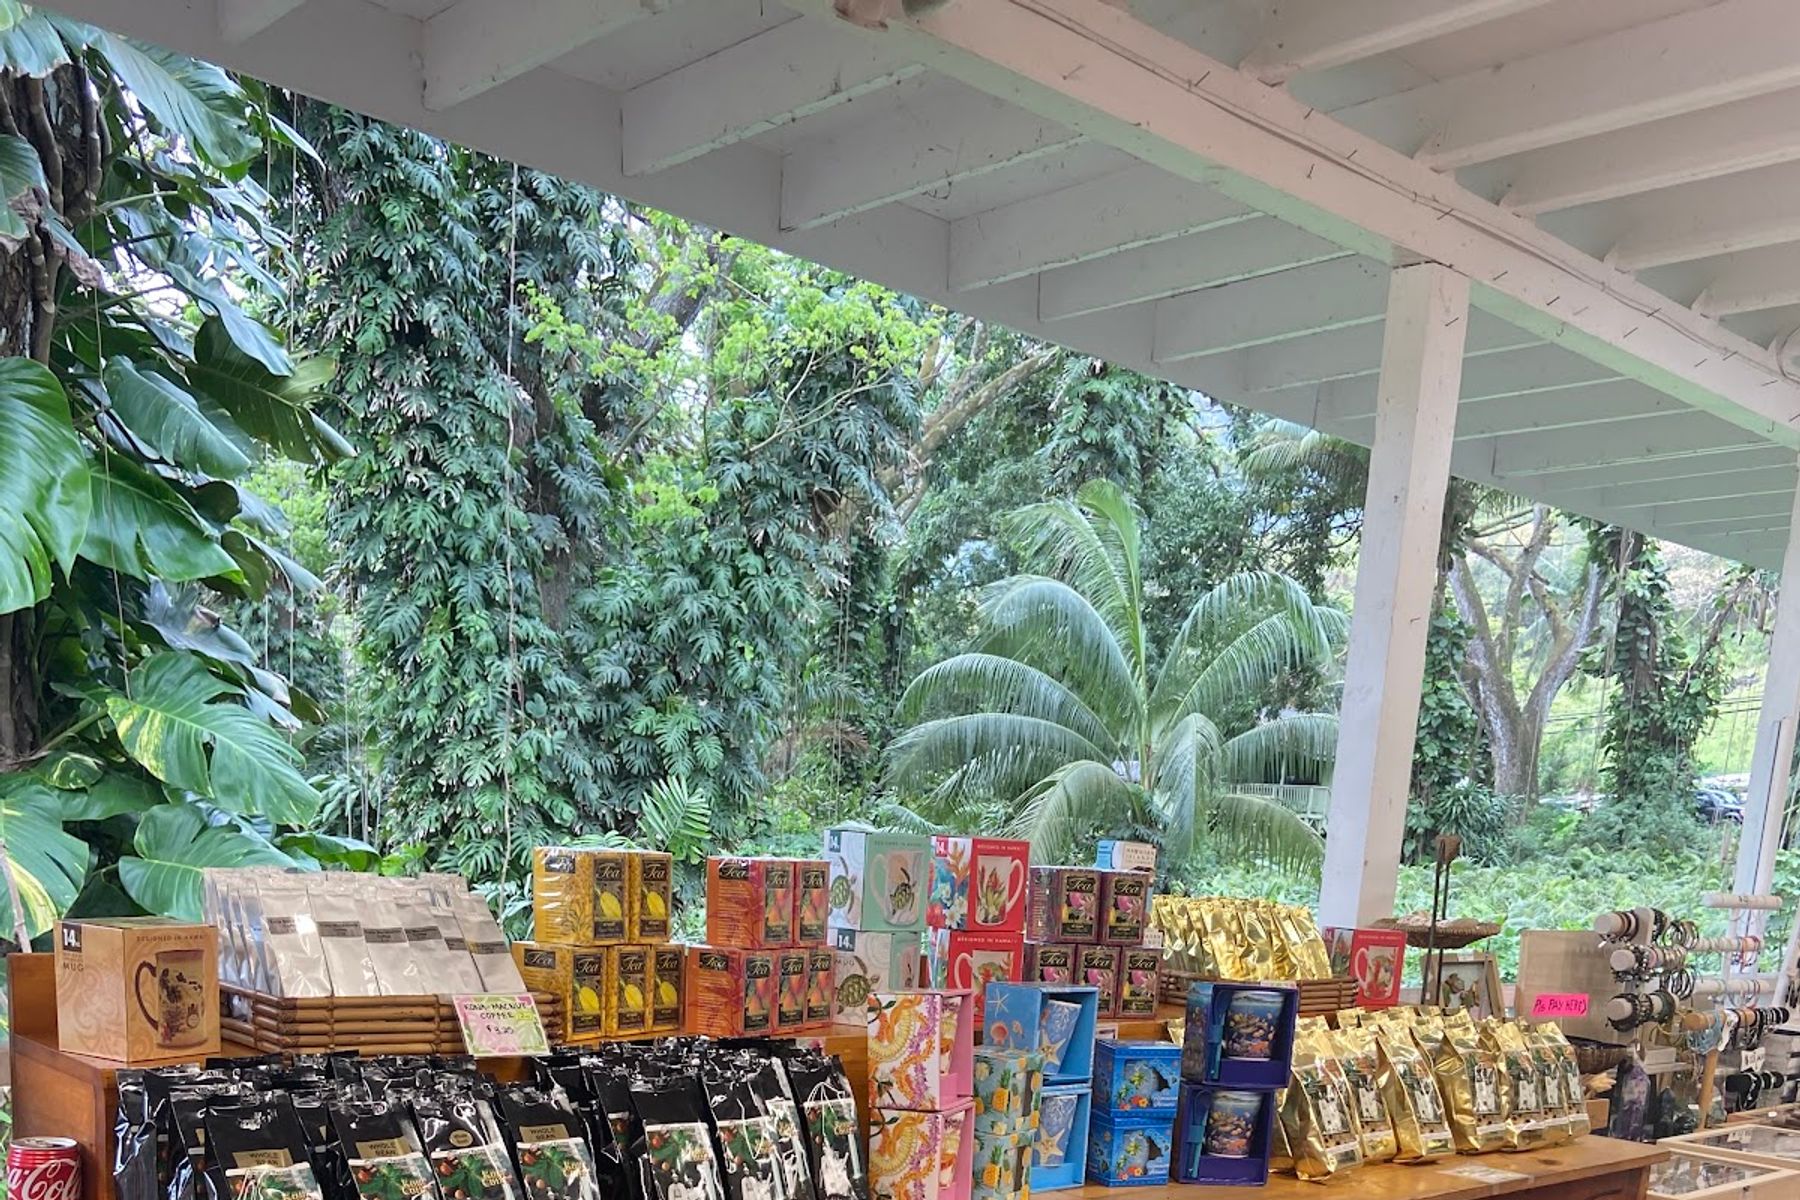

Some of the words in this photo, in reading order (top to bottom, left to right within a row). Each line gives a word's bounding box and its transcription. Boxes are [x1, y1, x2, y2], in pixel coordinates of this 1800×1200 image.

[596, 863, 620, 880] Tea
[643, 863, 665, 880] Tea
[767, 872, 787, 886] Tea
[803, 871, 823, 886] Tea
[1068, 879, 1093, 892] Tea
[1116, 883, 1140, 894] Tea
[620, 956, 643, 972] Tea
[656, 954, 678, 970] Tea
[810, 956, 830, 969] Tea
[1041, 952, 1066, 965] Tea
[1085, 955, 1110, 967] Tea
[1130, 957, 1154, 969] Tea
[63, 962, 84, 972] MUG
[575, 958, 600, 974] Tea
[748, 962, 768, 976] Tea
[781, 960, 802, 973] Tea
[530, 1127, 556, 1135] WHOLE
[368, 1142, 397, 1151] WHOLE
[250, 1151, 280, 1159] WHOLE
